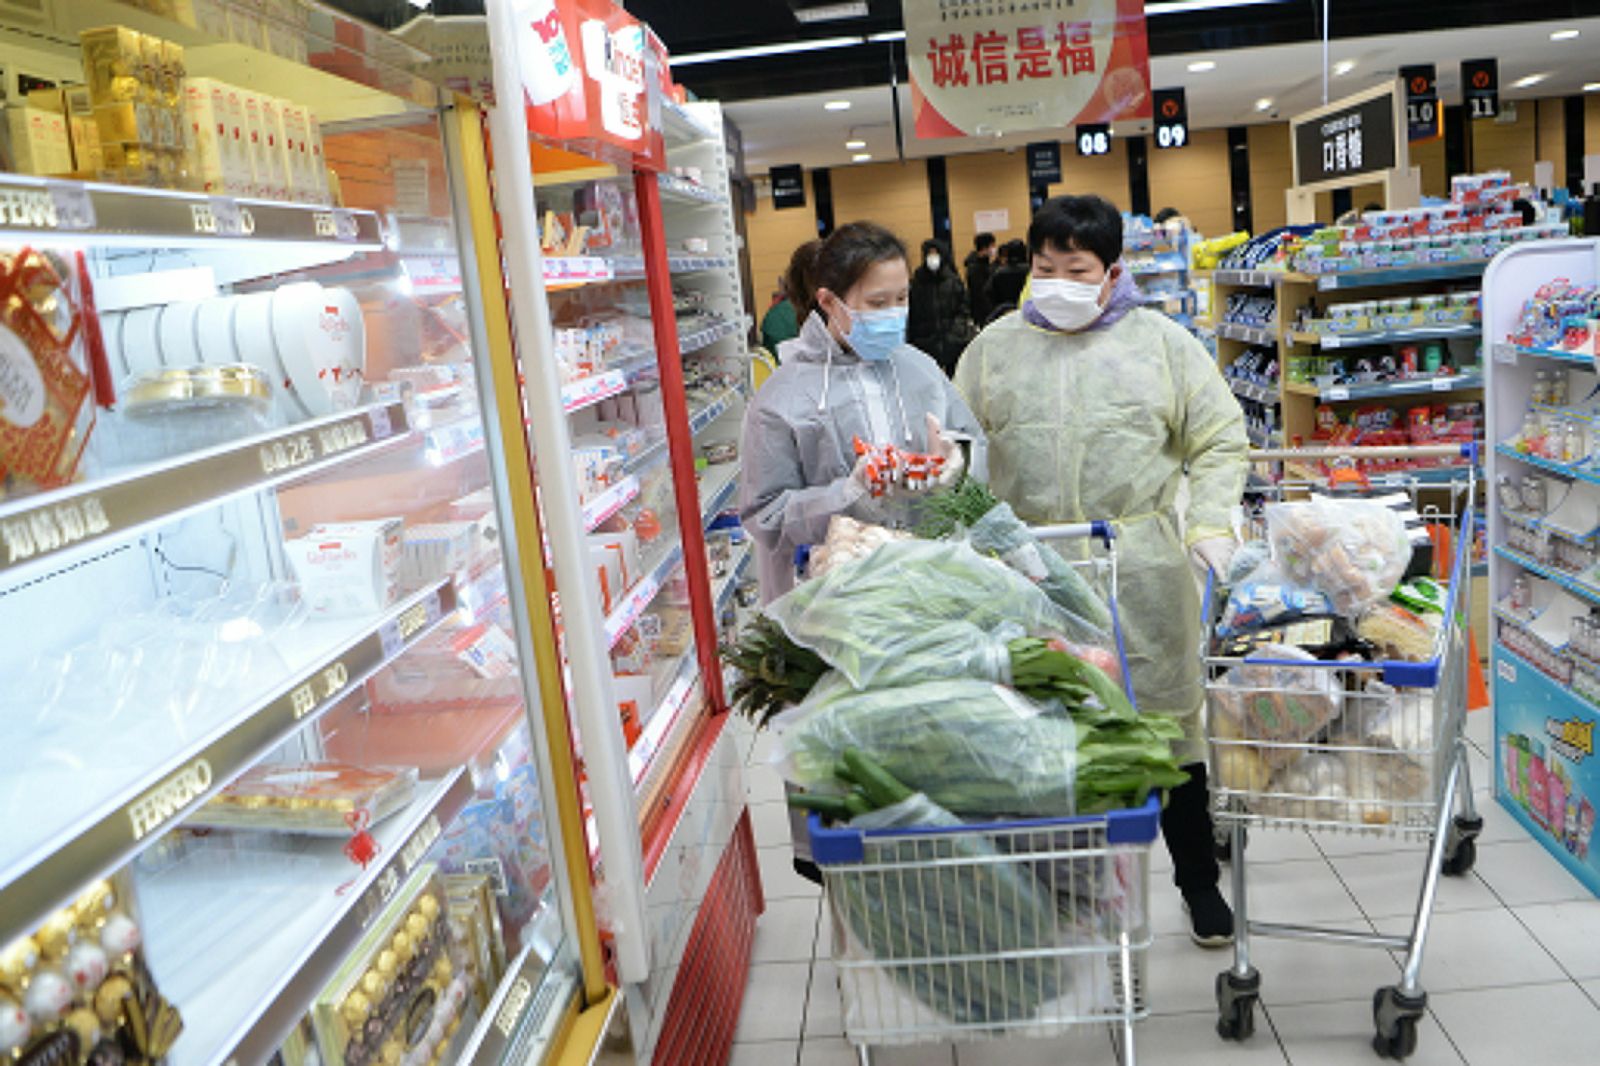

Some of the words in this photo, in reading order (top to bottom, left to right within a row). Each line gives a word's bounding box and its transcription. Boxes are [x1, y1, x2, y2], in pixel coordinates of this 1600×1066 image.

[926, 21, 1095, 90] 诚信是福
[1407, 102, 1434, 122] 10
[1471, 98, 1495, 117] 11
[1080, 132, 1108, 155] 08
[1158, 124, 1186, 148] 09
[128, 759, 212, 840] FERRERO
